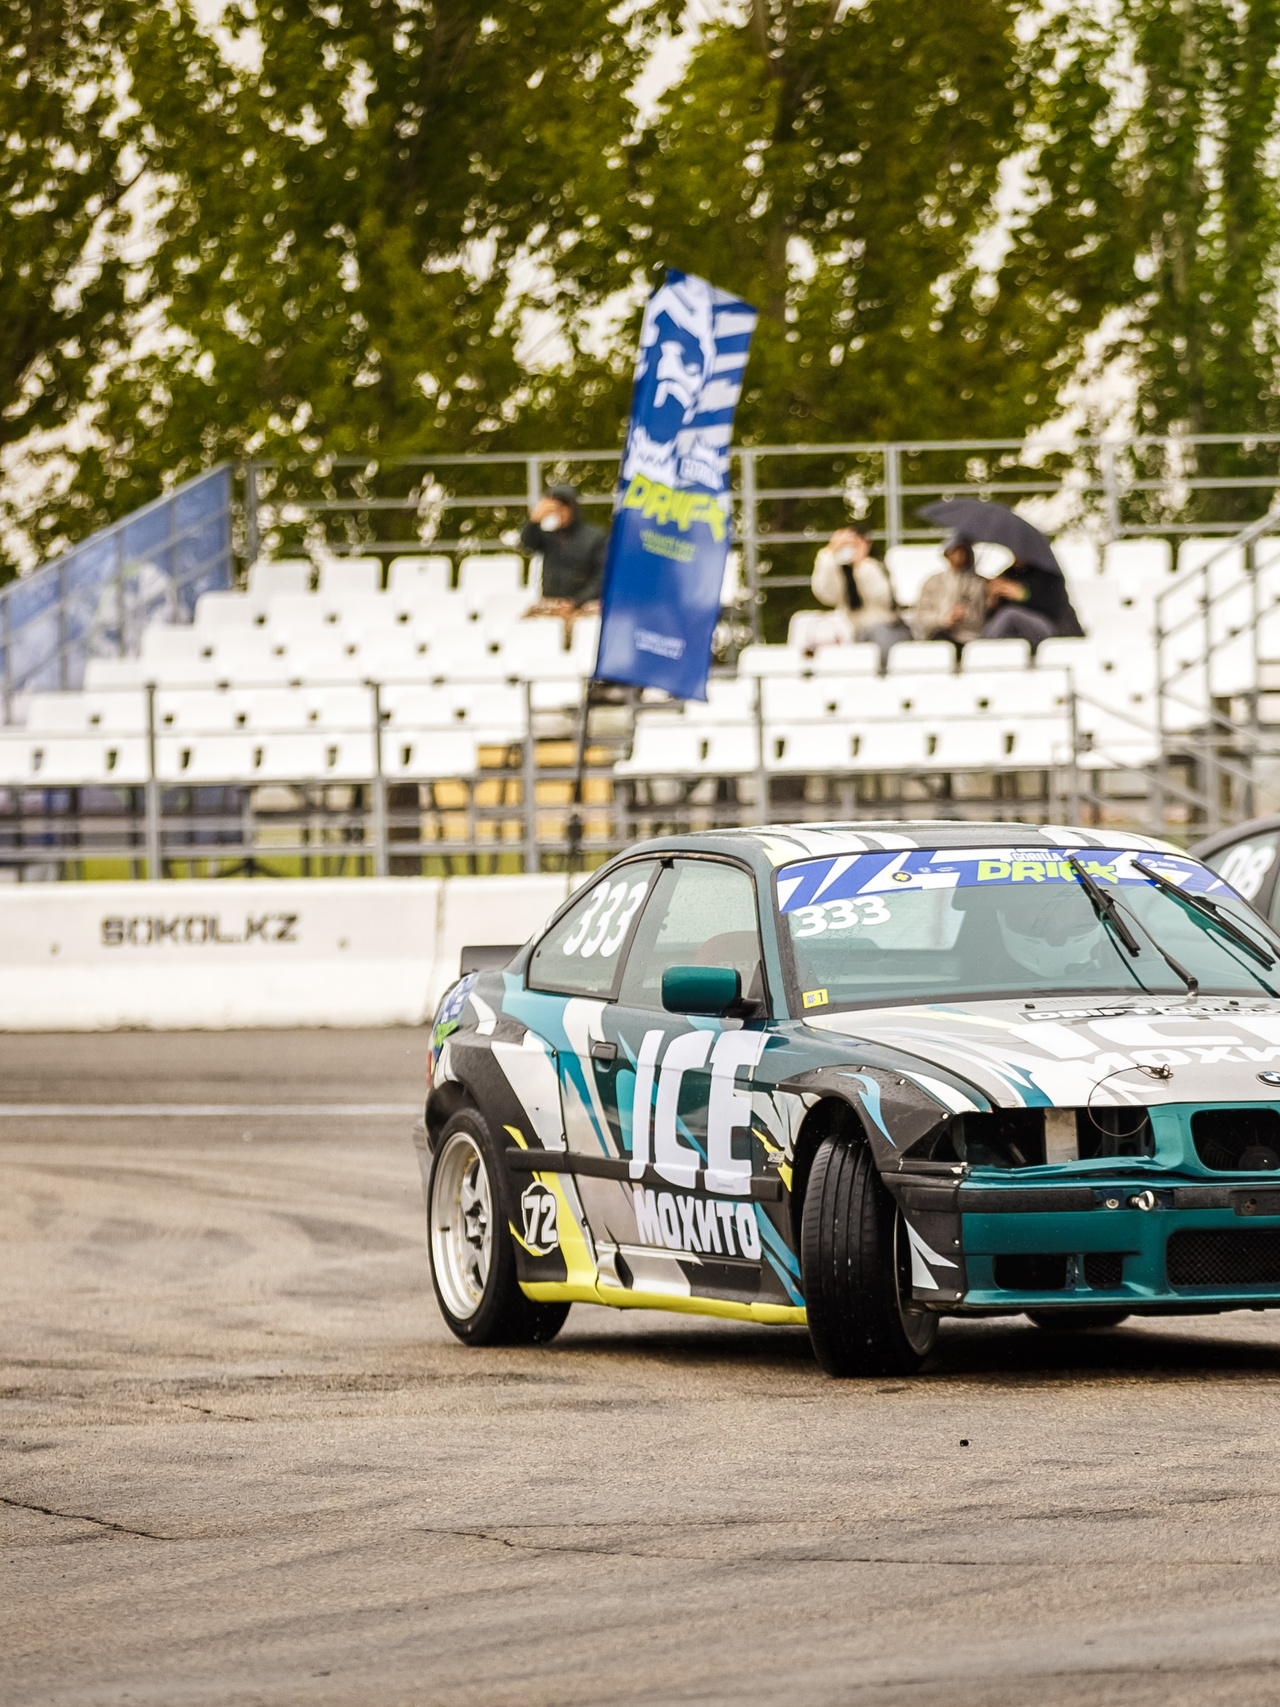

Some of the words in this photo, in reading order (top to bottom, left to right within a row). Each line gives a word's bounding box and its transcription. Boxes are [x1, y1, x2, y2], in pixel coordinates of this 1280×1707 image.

[1010, 852, 1064, 862] GORILLA
[1218, 844, 1277, 902] 08
[563, 881, 649, 958] 333
[793, 895, 891, 937] 333
[1027, 1007, 1153, 1021] DRIFT
[629, 1029, 772, 1195] ICE
[523, 1194, 557, 1244] 72
[633, 1189, 762, 1260] МОХИТО
